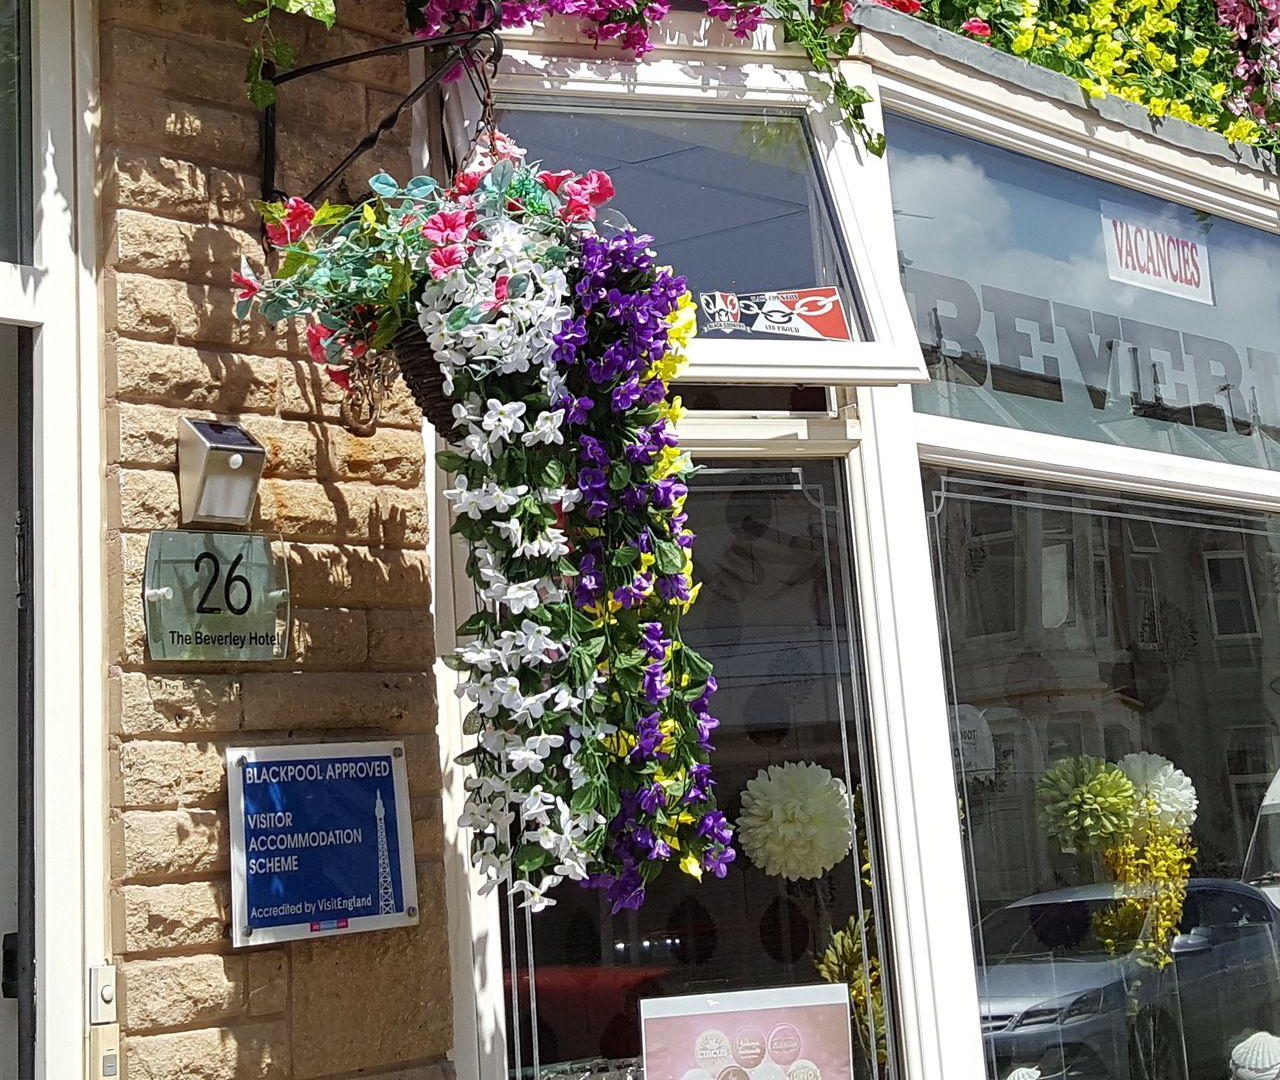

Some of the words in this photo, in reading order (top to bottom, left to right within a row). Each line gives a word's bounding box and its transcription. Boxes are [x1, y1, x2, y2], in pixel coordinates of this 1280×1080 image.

[1112, 219, 1201, 289] VACANCIES
[194, 551, 252, 616] 26
[169, 631, 192, 645] The
[194, 631, 246, 649] Beverley
[249, 632, 280, 646] Hotel
[246, 764, 323, 784] BLACKPOOL
[326, 761, 390, 781] APPROVED
[247, 811, 293, 830] VISITOR
[248, 828, 363, 852] ACCOMMODATION
[249, 856, 299, 874] SCHEME
[251, 900, 302, 919] Accredited
[304, 899, 317, 915] by
[317, 894, 372, 911] VisitEngland
